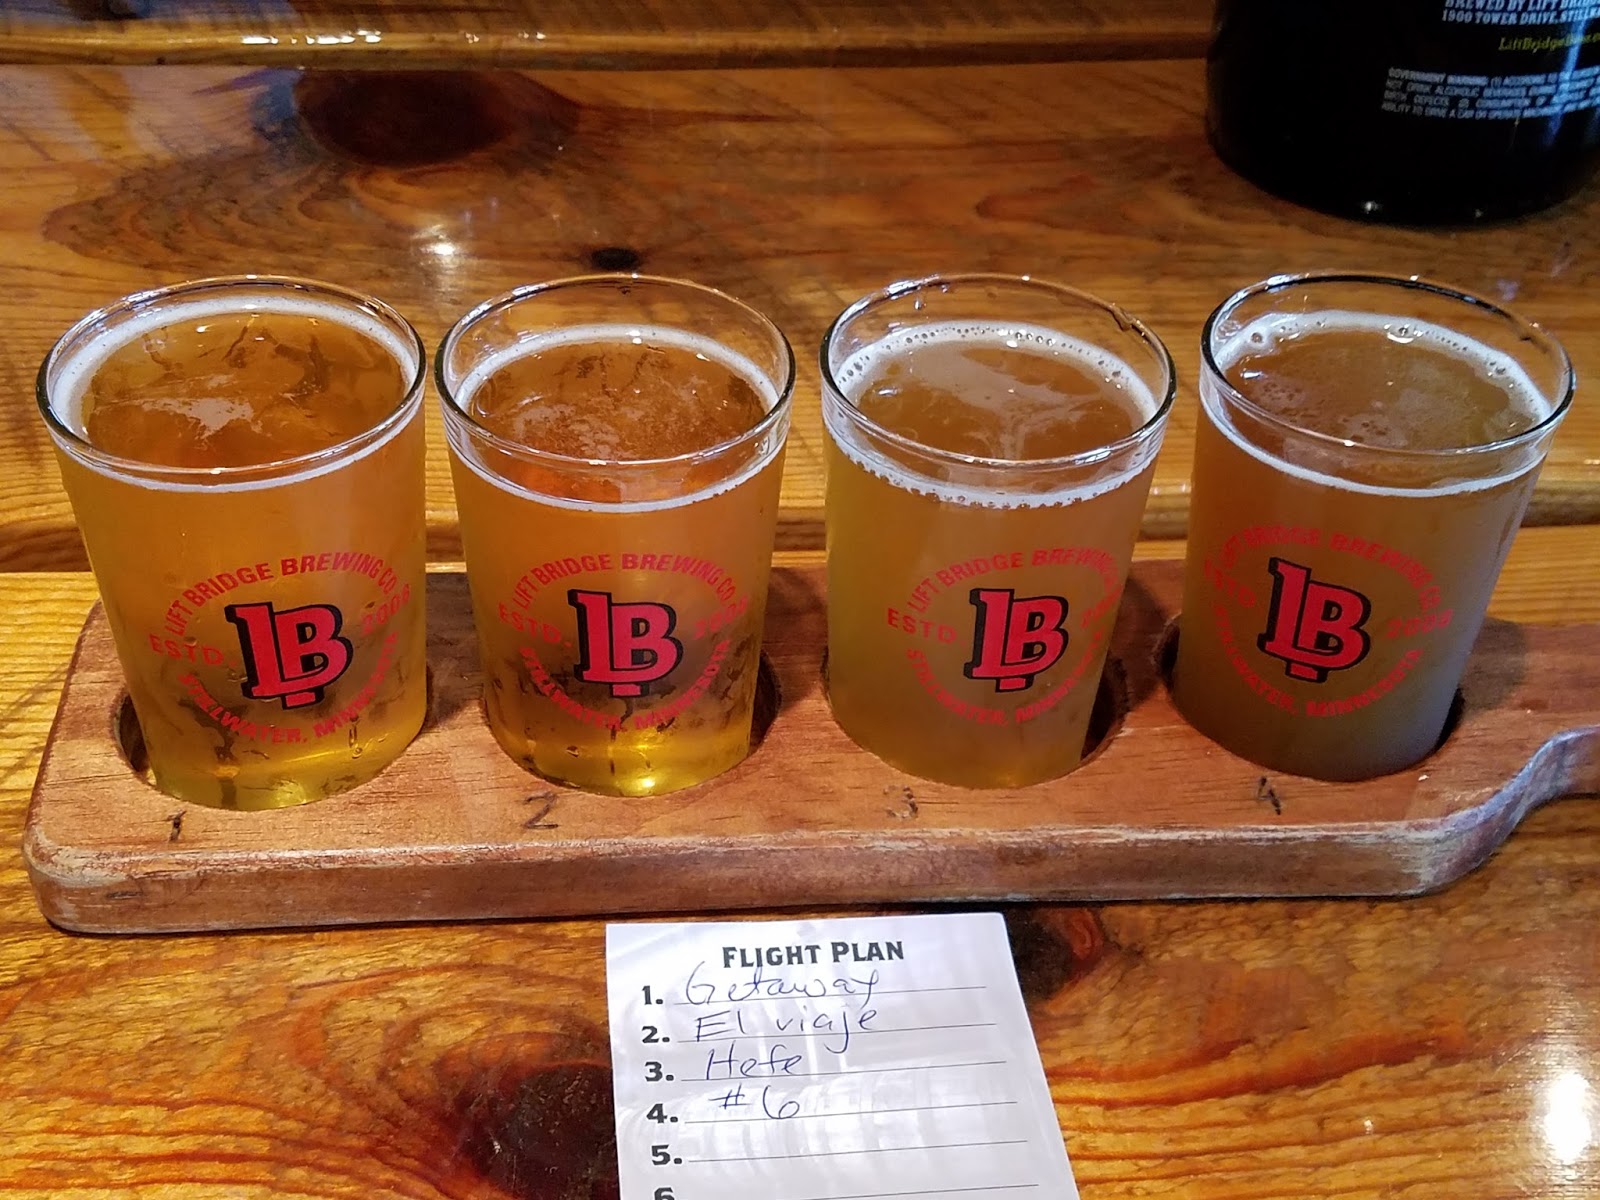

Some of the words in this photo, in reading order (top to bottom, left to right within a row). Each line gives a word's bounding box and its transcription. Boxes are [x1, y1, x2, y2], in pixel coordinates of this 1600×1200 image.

[1442, 9, 1473, 23] 1900
[1475, 11, 1518, 25] TOWER
[165, 599, 194, 637] LIFT
[182, 563, 274, 608] BRIDGE
[281, 552, 384, 579] BREWING
[513, 575, 535, 610] LIFT
[530, 554, 614, 586] BRIDGE
[622, 553, 725, 585] BREWING
[907, 578, 940, 614] LIFT
[936, 552, 1024, 588] BRIDGE
[166, 810, 188, 842] 1
[521, 791, 560, 830] 2
[723, 943, 821, 969] FLIGHT
[832, 940, 905, 963] PLAN
[641, 985, 664, 1006] 1.
[686, 961, 881, 1006] Getaway
[641, 1025, 671, 1045] 2.
[695, 1009, 746, 1042] El
[775, 1005, 878, 1054] viaje
[644, 1061, 675, 1083] 3.
[706, 1040, 803, 1080] Hefe
[646, 1103, 679, 1124] 4.
[651, 1144, 683, 1166] 5.
